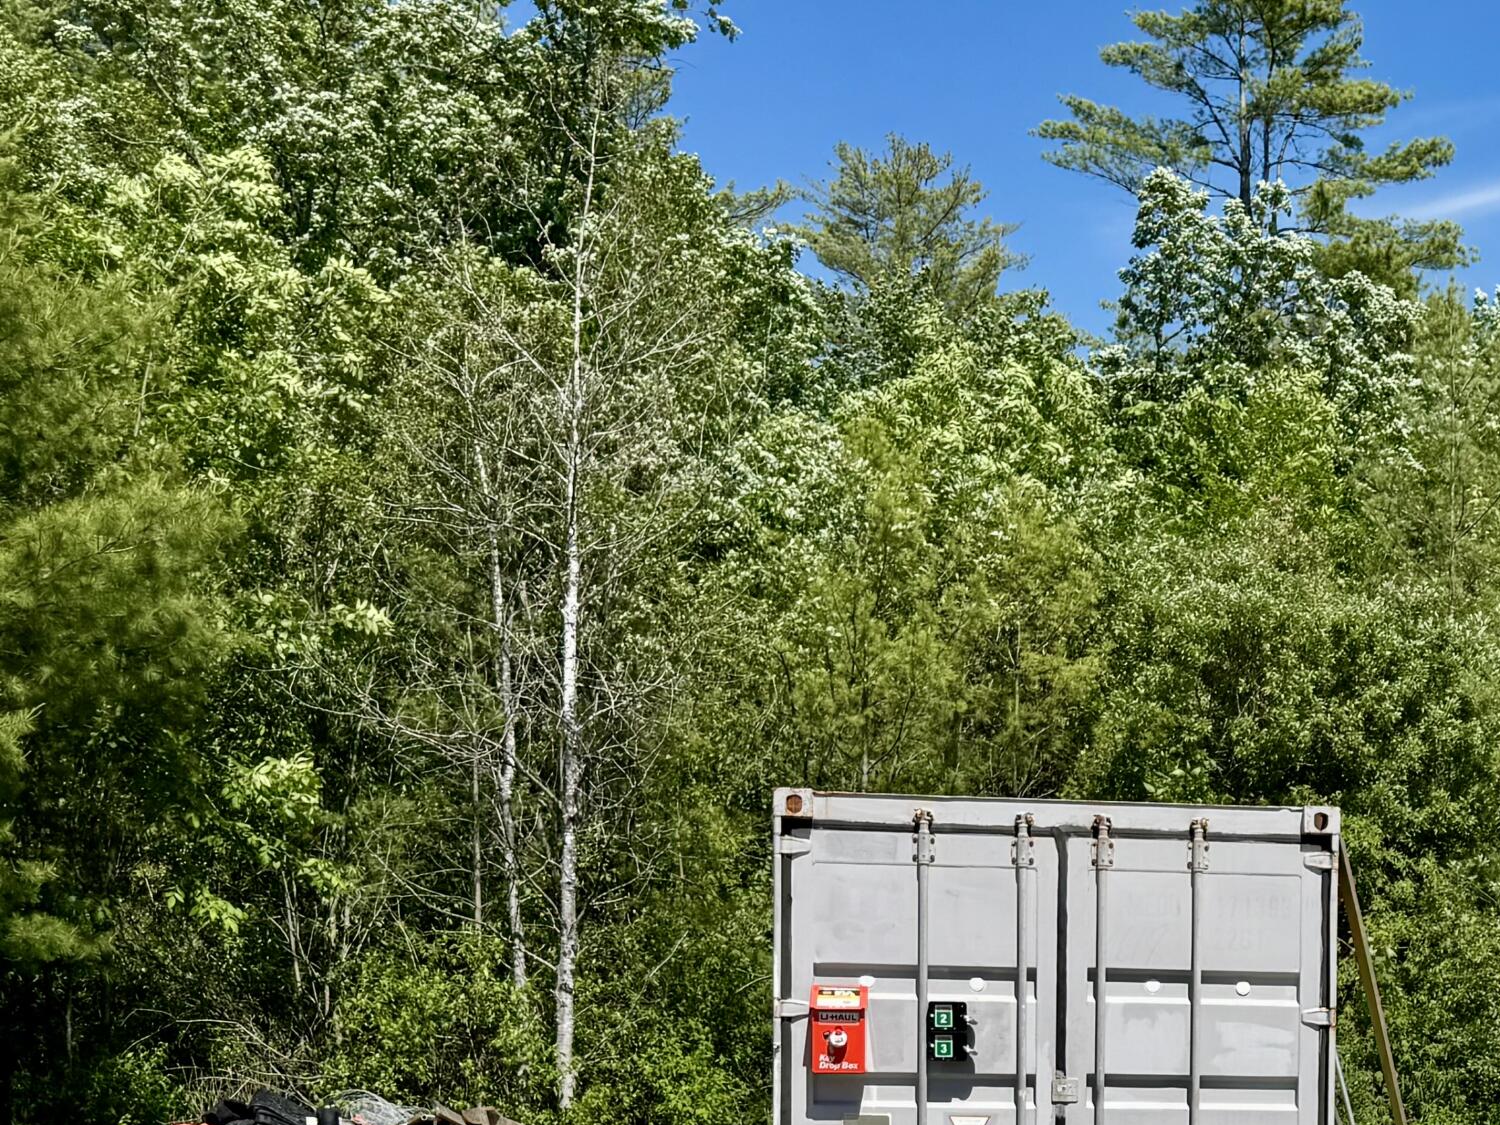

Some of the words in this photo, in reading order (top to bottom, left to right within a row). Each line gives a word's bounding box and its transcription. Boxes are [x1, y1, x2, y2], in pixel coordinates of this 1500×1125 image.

[820, 1012, 858, 1021] U-HAUL
[940, 1013, 948, 1024] 2
[940, 1043, 948, 1054] 3
[819, 1061, 841, 1070] Drop
[841, 1061, 859, 1070] Box
